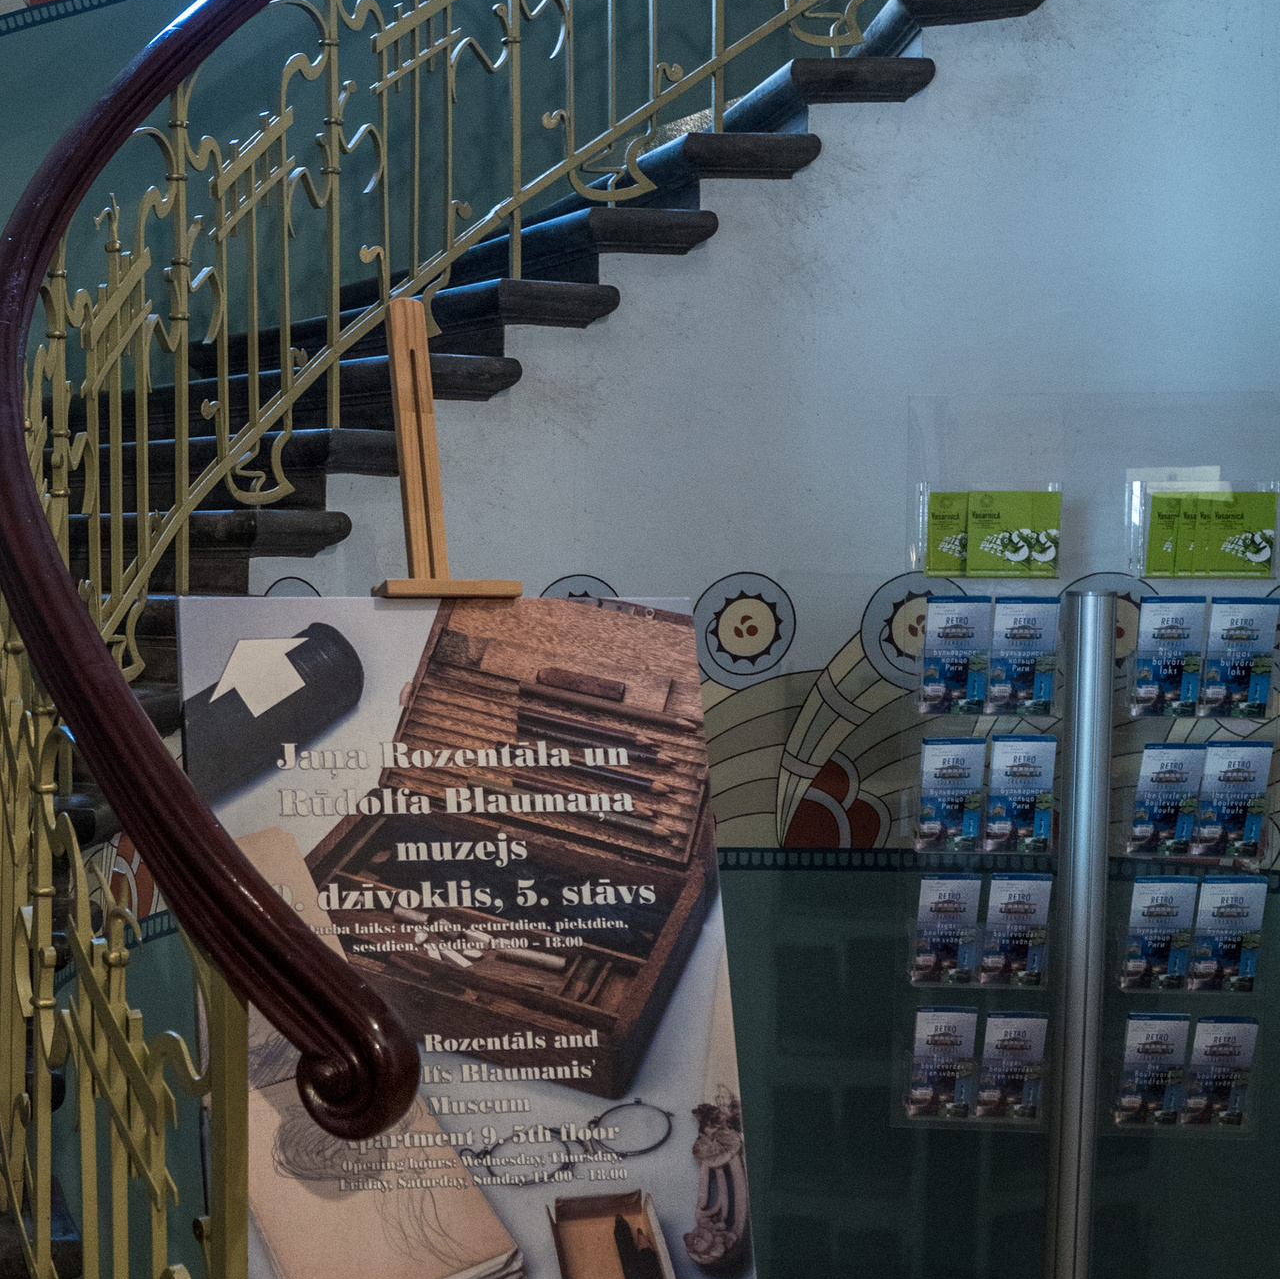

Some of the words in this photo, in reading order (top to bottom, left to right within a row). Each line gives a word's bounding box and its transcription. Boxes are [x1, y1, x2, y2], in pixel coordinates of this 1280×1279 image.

[946, 617, 969, 625] RETRO
[1013, 617, 1037, 626] RETRO
[1161, 617, 1185, 626] RETRO
[1230, 618, 1254, 627] RETRO
[277, 741, 370, 780] Jaņa
[380, 739, 572, 770] Rozentāla
[584, 746, 631, 767] un
[942, 758, 965, 766] RETRO
[1013, 756, 1037, 764] RETRO
[1160, 762, 1184, 770] RETRO
[1227, 761, 1251, 769] RETRO
[279, 788, 433, 818] Rūdolfa
[444, 786, 636, 822] Blaumaņa
[395, 832, 530, 868] muzejs
[317, 881, 505, 914] dzīvoklis,
[516, 879, 550, 908] 5.
[562, 878, 658, 906] stāvs
[938, 893, 961, 901] RETRO
[1008, 893, 1031, 902] RETRO
[1151, 896, 1174, 904] RETRO
[1220, 896, 1244, 904] RETRO
[355, 923, 396, 935] laiks:
[400, 920, 466, 935] trešdien,
[471, 919, 551, 933] ceturtdien,
[555, 918, 630, 932] piektdien,
[353, 939, 419, 953] sestdien,
[423, 937, 484, 952] svētdien
[544, 935, 583, 948] 18.00
[934, 1025, 957, 1033] RETRO
[1004, 1030, 1027, 1039] RETRO
[1146, 1034, 1169, 1042] RETRO
[424, 1032, 547, 1054] Rozentāls
[554, 1029, 601, 1050] and
[1213, 1036, 1237, 1044] RETRO
[427, 1095, 532, 1116] Museum
[513, 1125, 553, 1145] 5th
[561, 1123, 621, 1143] floor
[341, 1159, 405, 1175] Opening
[408, 1158, 456, 1170] hours:
[340, 1177, 394, 1193] Friday,
[473, 1173, 528, 1188] Sunday
[534, 1170, 573, 1184] 11.00
[588, 1167, 629, 1181] 18.00
